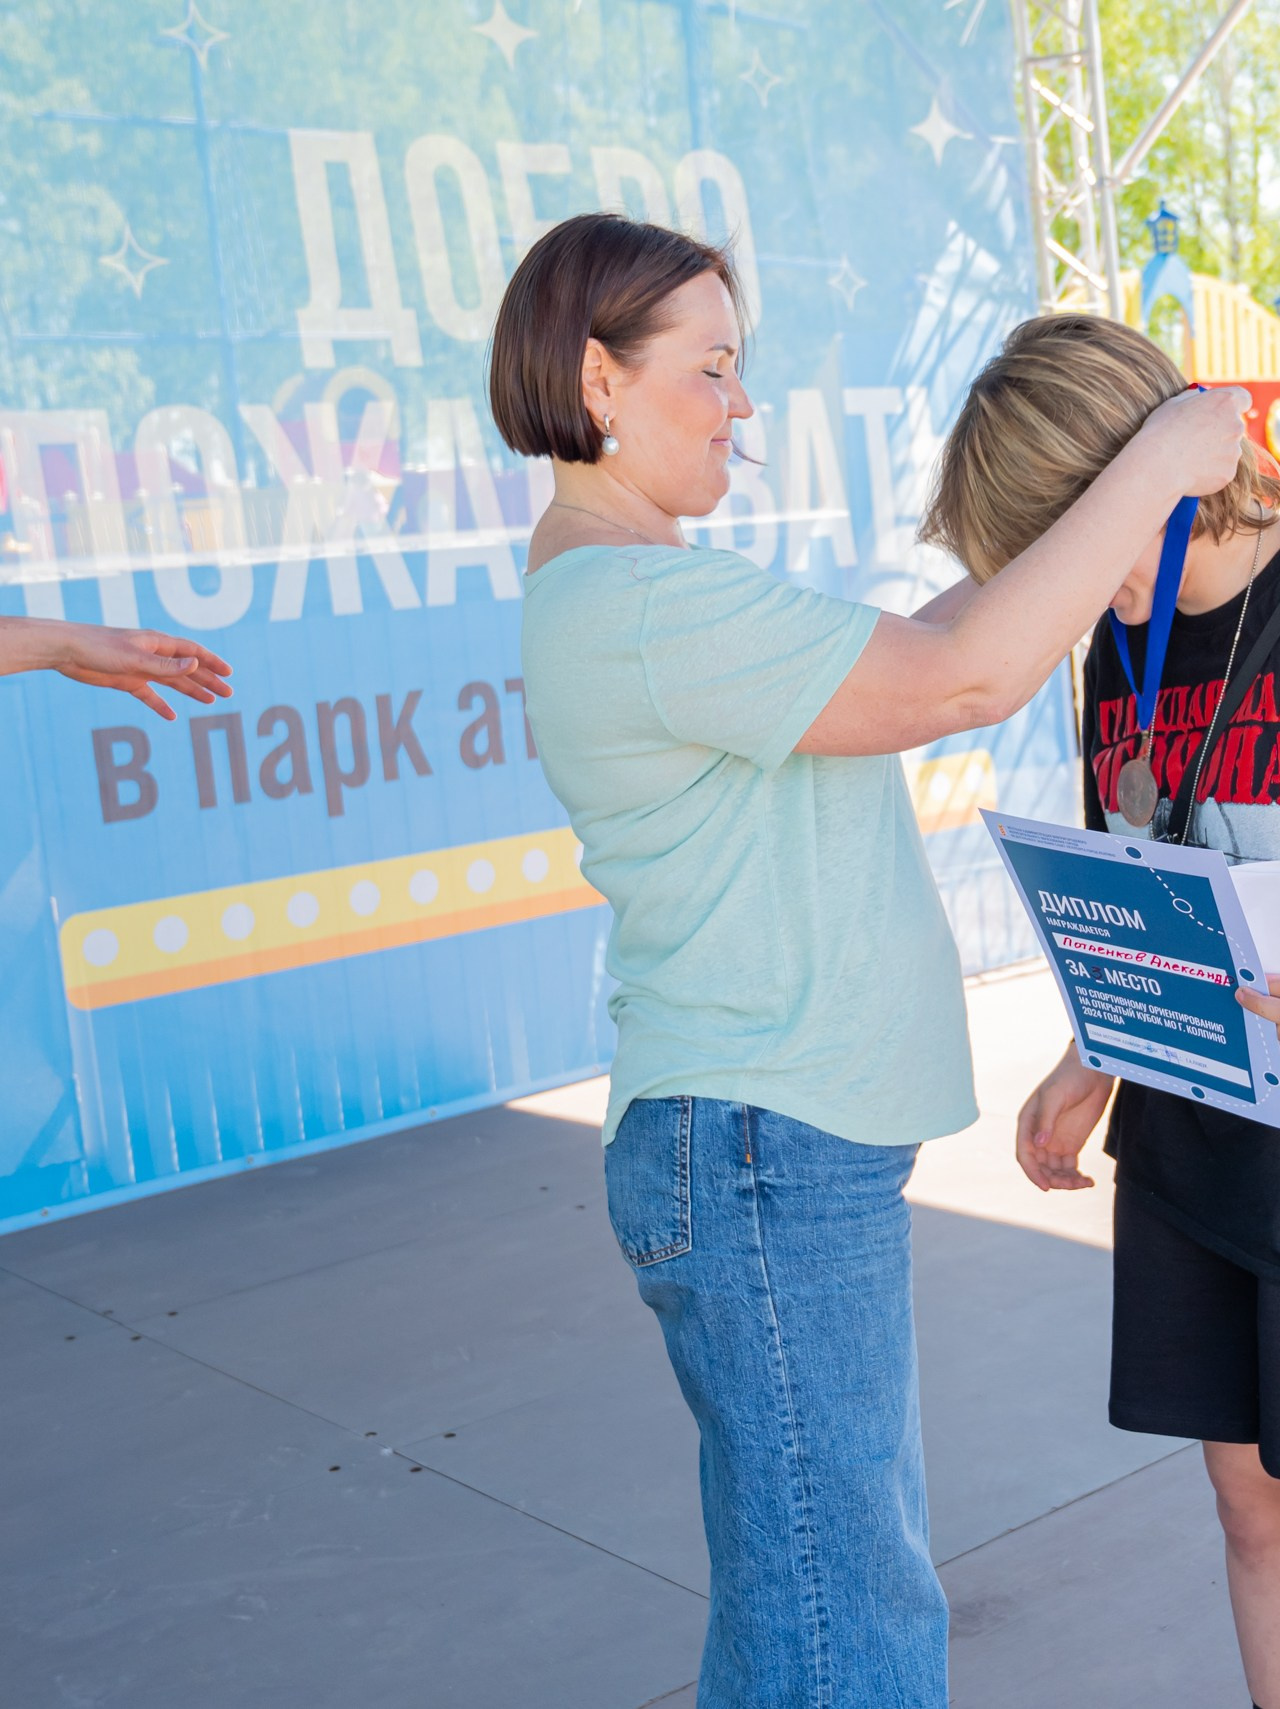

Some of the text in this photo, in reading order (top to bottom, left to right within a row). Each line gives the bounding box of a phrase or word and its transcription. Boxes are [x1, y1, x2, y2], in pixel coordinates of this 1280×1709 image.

[0, 386, 930, 631] ПОЖАВАТ
[91, 676, 540, 824] в парк ат
[1038, 890, 1146, 931] ДИПЛОМ
[1046, 917, 1111, 938] НАГРАЖДАЕТСЯ
[1065, 959, 1091, 979] ЗА
[1104, 968, 1162, 996] МЕСТО
[1075, 985, 1225, 1034] ПО СПОРТИВНОМУ ОРИЕНТИРОВАНИЮ
[1078, 996, 1091, 1006] НА
[1092, 999, 1136, 1018] ОТКРЫТЫЙ
[1136, 1010, 1164, 1026] КУБОК
[1164, 1018, 1178, 1030] МО
[1186, 1025, 1227, 1045] КОЛПИНО
[1082, 1006, 1126, 1025] 2024 ГОДА
